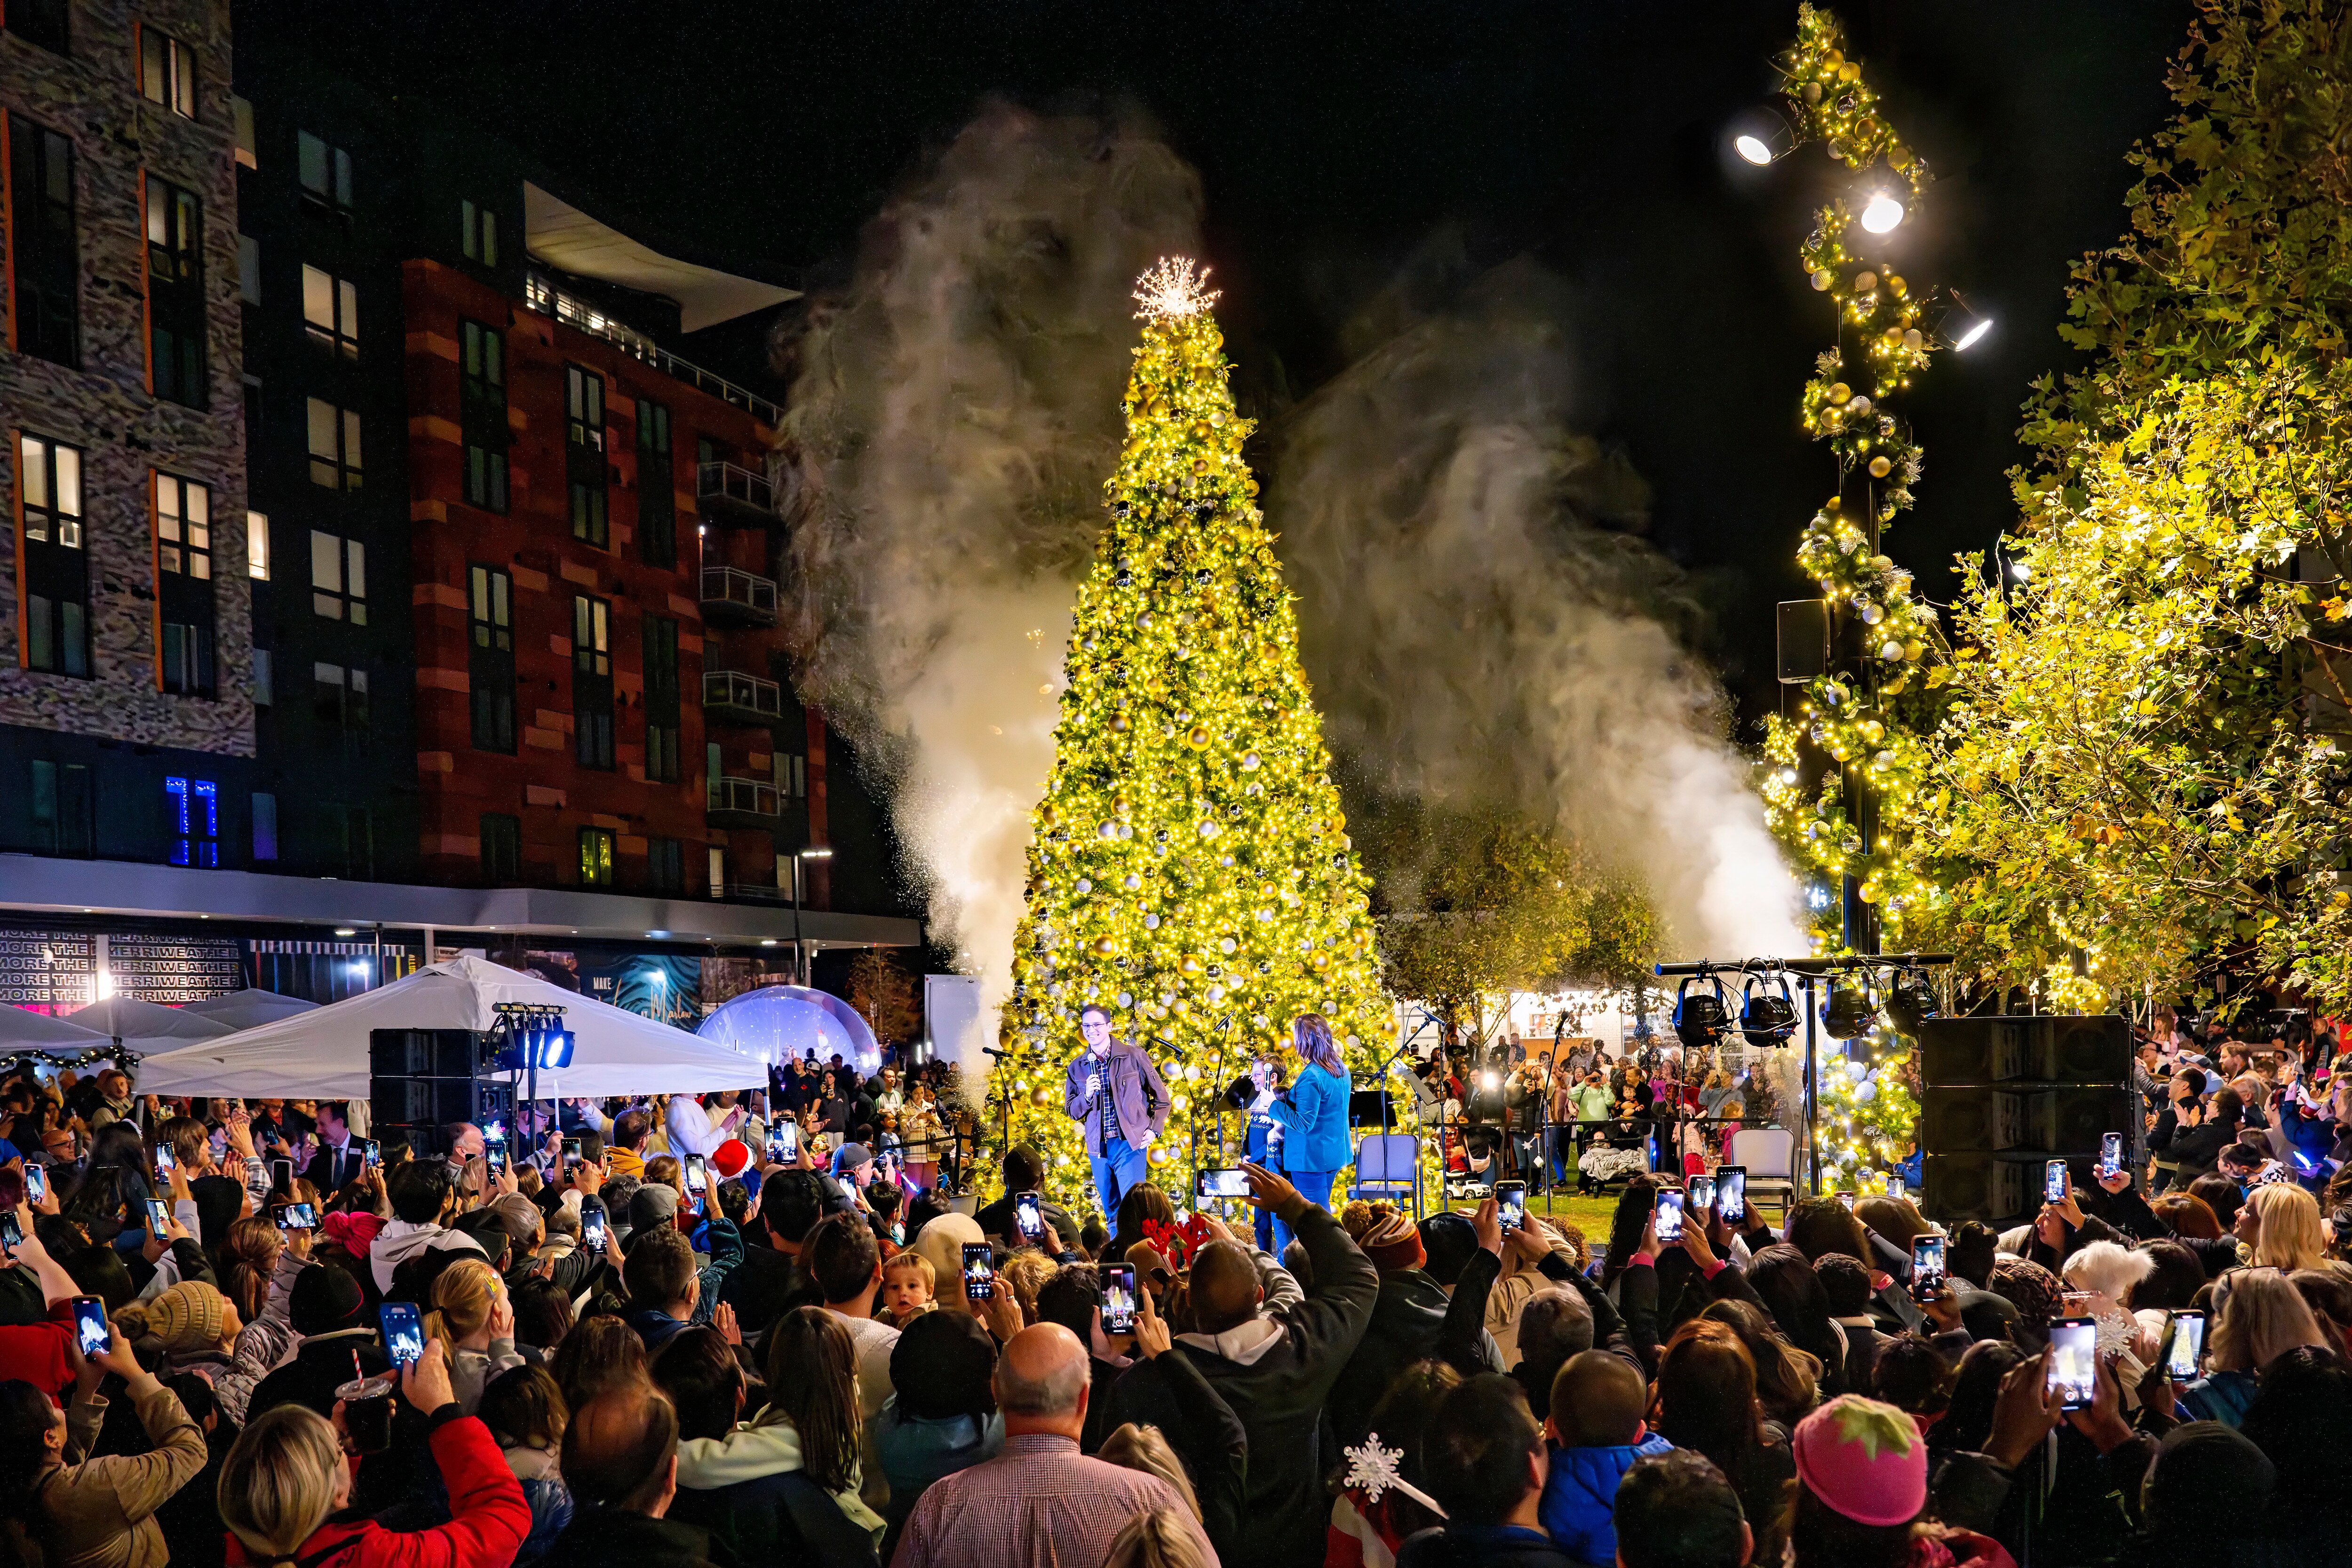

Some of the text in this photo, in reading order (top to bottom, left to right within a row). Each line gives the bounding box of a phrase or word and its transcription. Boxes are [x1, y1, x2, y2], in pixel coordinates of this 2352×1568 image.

[51, 943, 88, 955] THE
[52, 958, 88, 971] THE
[52, 973, 89, 986] THE
[593, 977, 612, 990] MAKE
[52, 989, 89, 1001] THE
